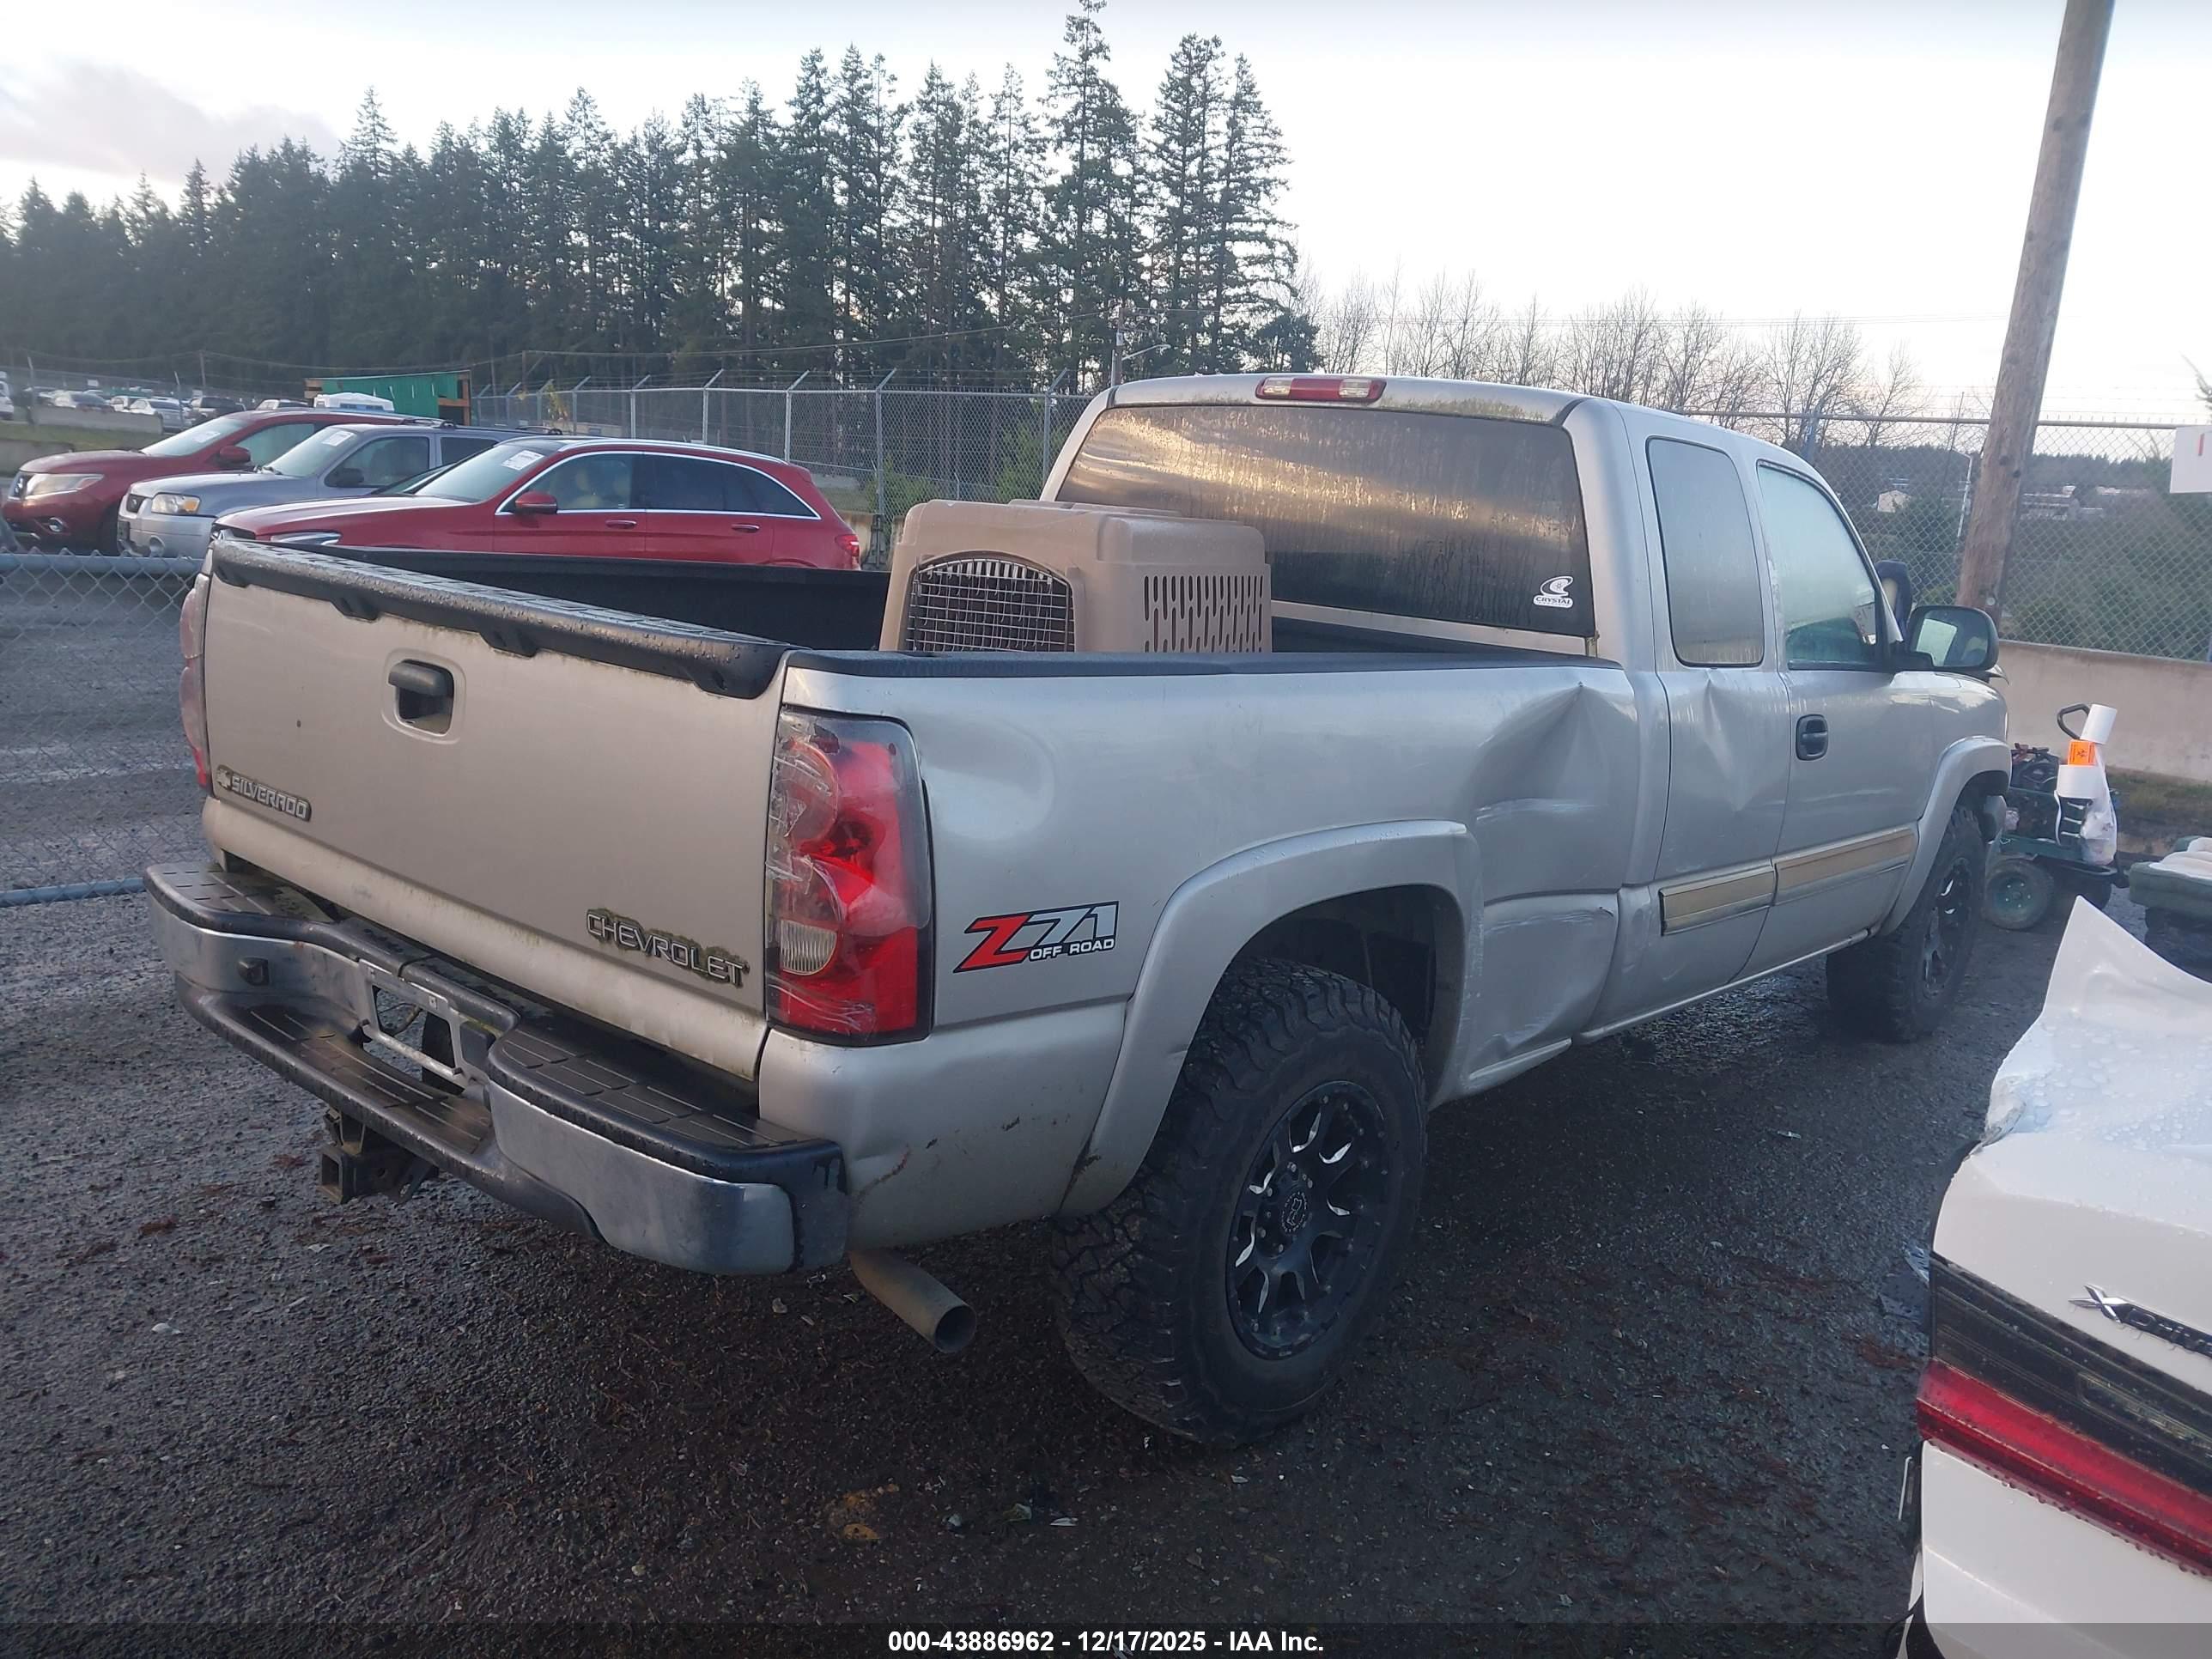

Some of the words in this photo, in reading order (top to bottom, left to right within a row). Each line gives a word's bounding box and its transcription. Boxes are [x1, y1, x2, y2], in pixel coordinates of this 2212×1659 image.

[231, 775, 307, 819] SILVERADO
[586, 912, 744, 985] CHEVROLET
[953, 901, 1119, 973] Z71
[1030, 945, 1063, 961] OFF
[1068, 938, 1115, 955] ROAD
